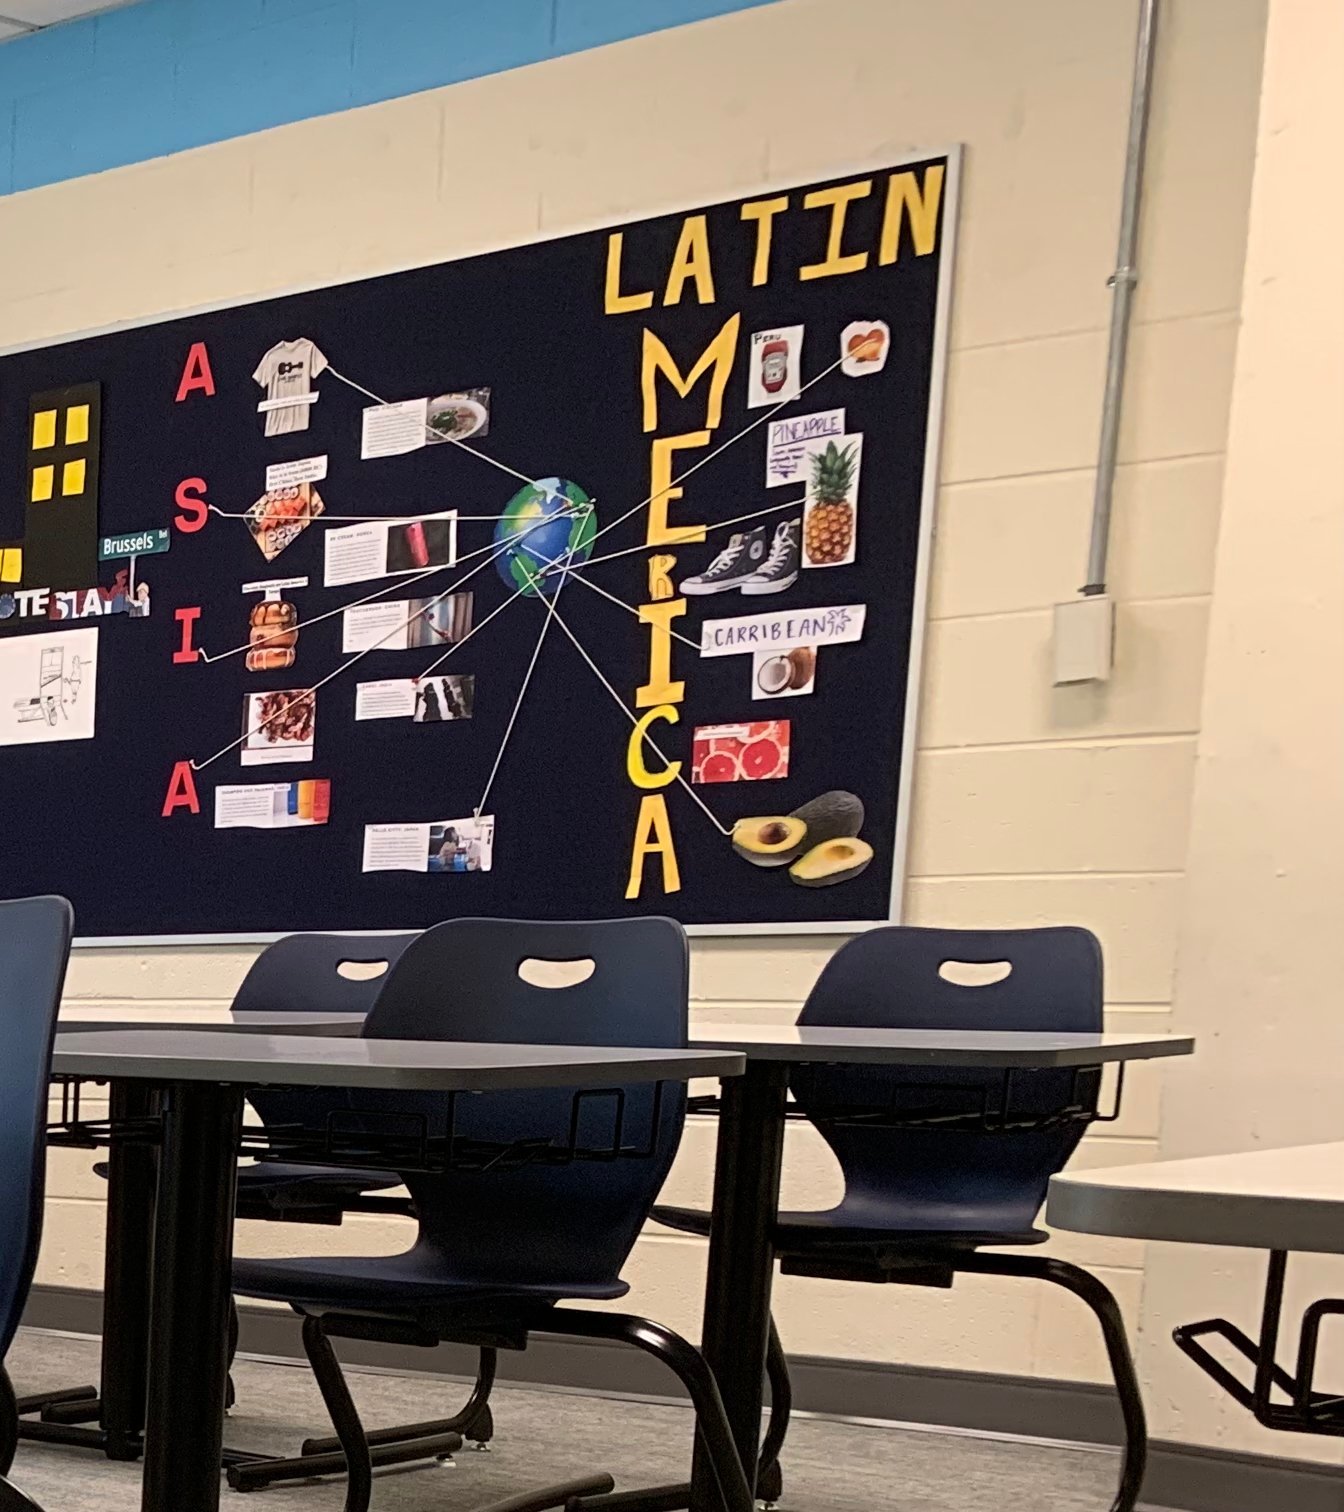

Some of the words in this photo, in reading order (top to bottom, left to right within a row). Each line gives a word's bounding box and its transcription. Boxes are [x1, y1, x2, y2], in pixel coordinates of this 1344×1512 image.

[604, 165, 945, 315] LATIN
[772, 416, 840, 444] PINEAPPLE
[103, 532, 154, 555] Brussels
[162, 342, 216, 817] ASIA
[715, 616, 826, 647] CARRIBEAN
